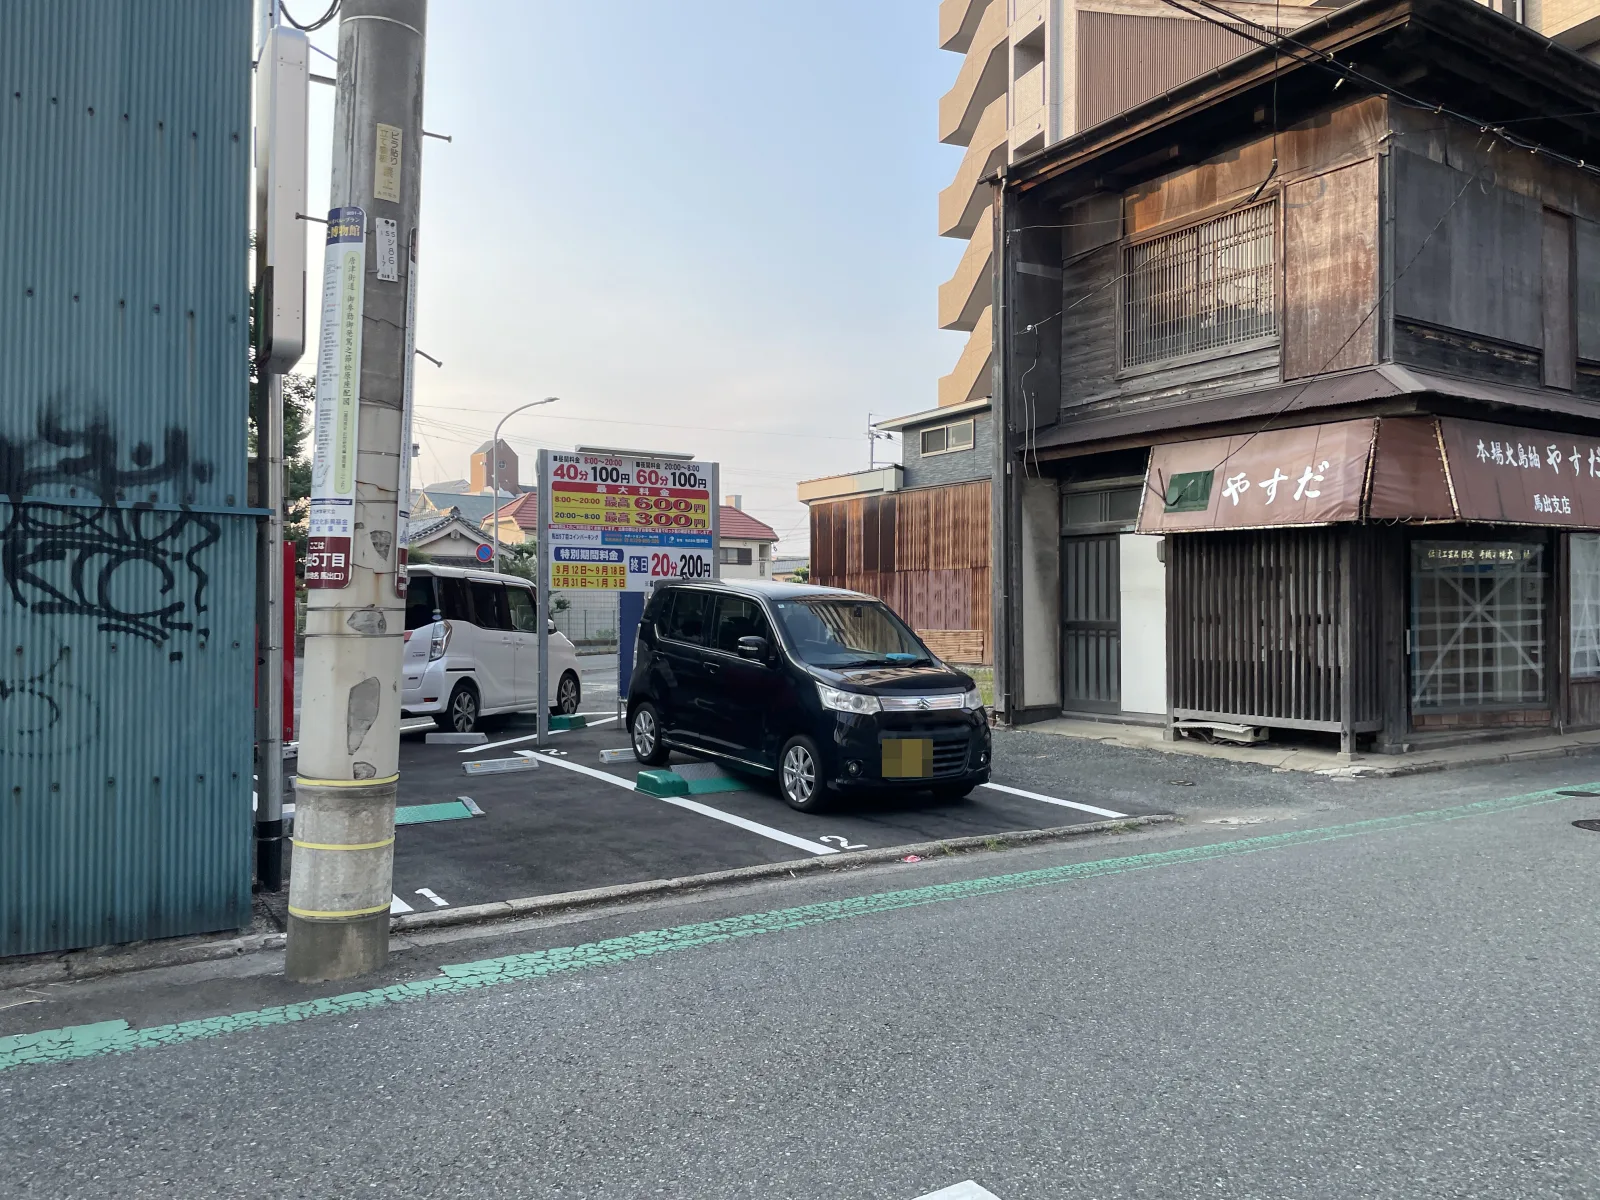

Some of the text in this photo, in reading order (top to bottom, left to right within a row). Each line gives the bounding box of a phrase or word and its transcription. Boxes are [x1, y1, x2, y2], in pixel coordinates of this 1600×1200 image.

[1476, 438, 1541, 469] 本場大島紬
[553, 463, 630, 484] 40分 100円
[636, 469, 707, 489] 60分 100円
[1221, 460, 1330, 507] やすだ
[1533, 493, 1572, 515] 馬出支店
[559, 548, 619, 561] 特別期間料金
[680, 554, 711, 578] 200円
[819, 835, 869, 850] 2
